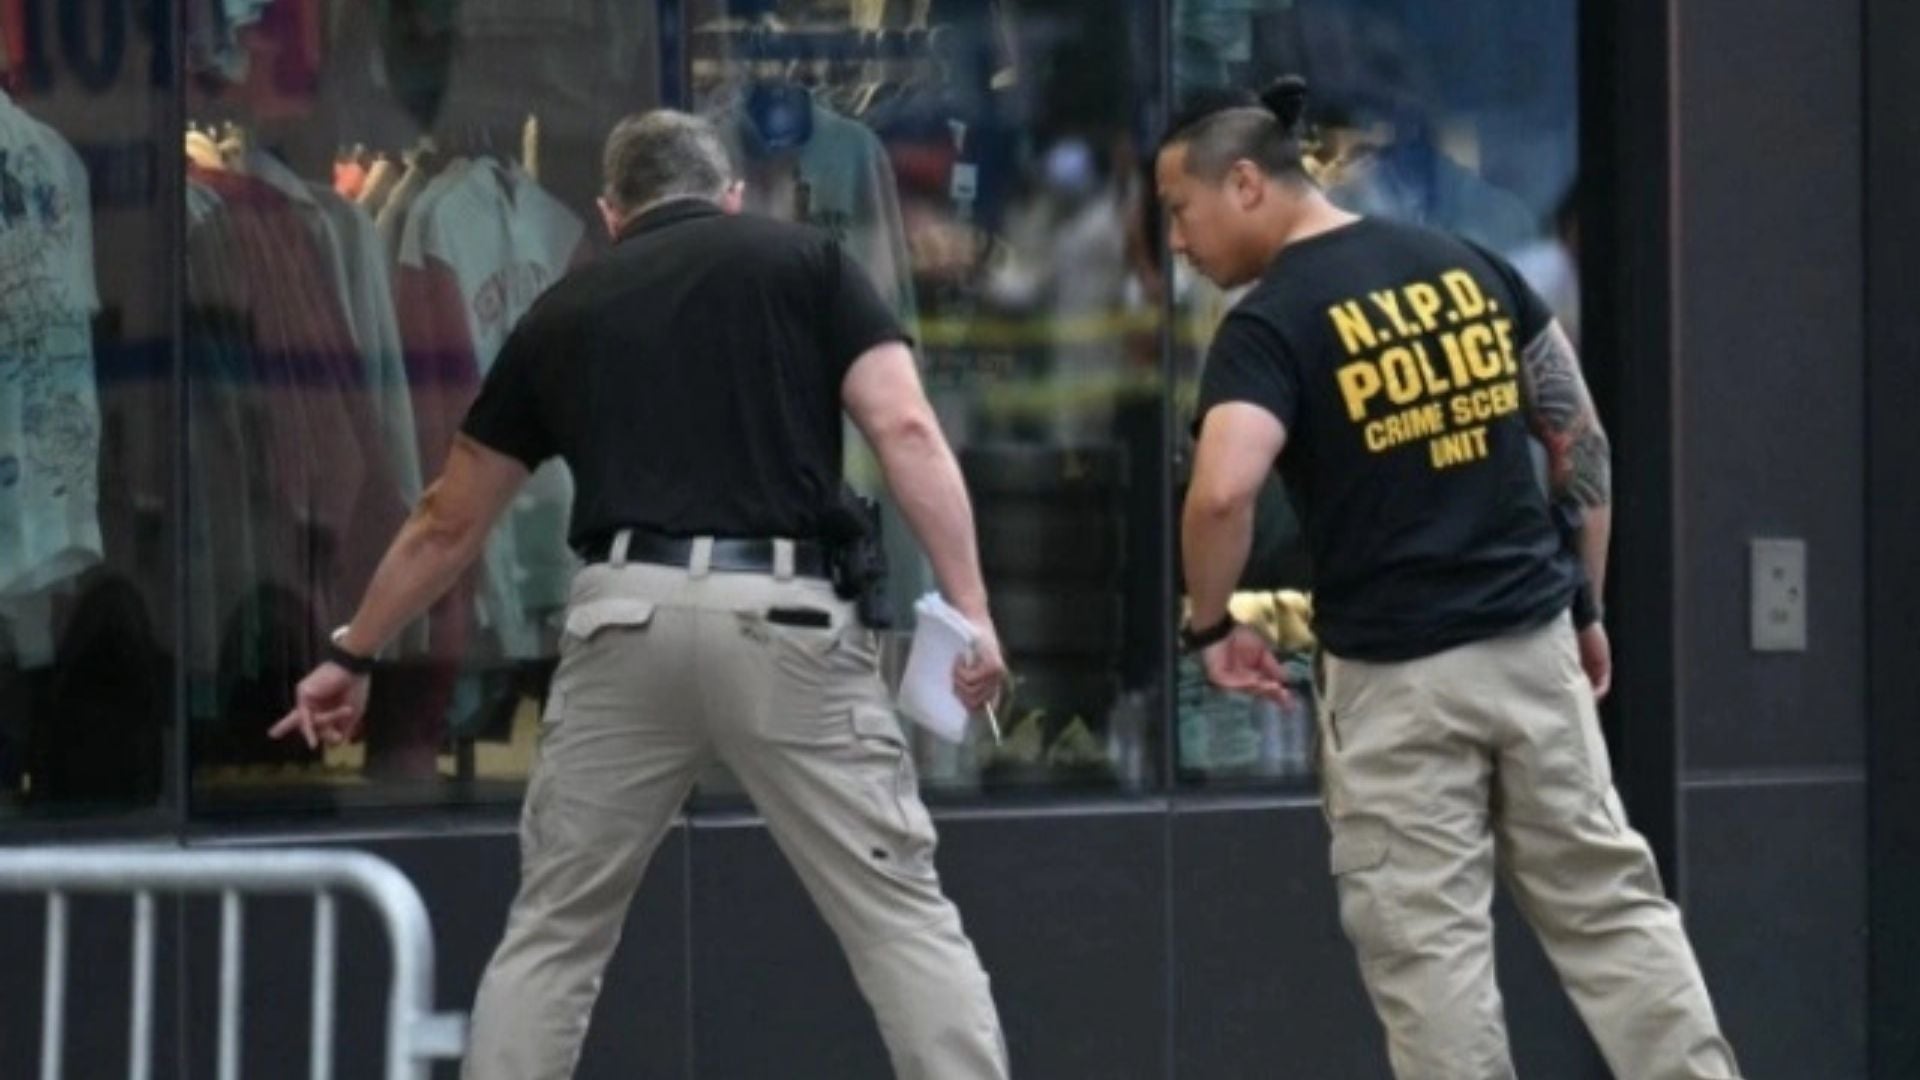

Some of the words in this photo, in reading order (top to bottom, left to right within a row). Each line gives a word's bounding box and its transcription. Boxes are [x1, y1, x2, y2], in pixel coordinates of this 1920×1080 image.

[1328, 268, 1498, 354] N.Y.P.D.
[1336, 318, 1517, 422] POLICE
[1364, 402, 1445, 452] CRIME
[1430, 427, 1488, 469] UNIT
